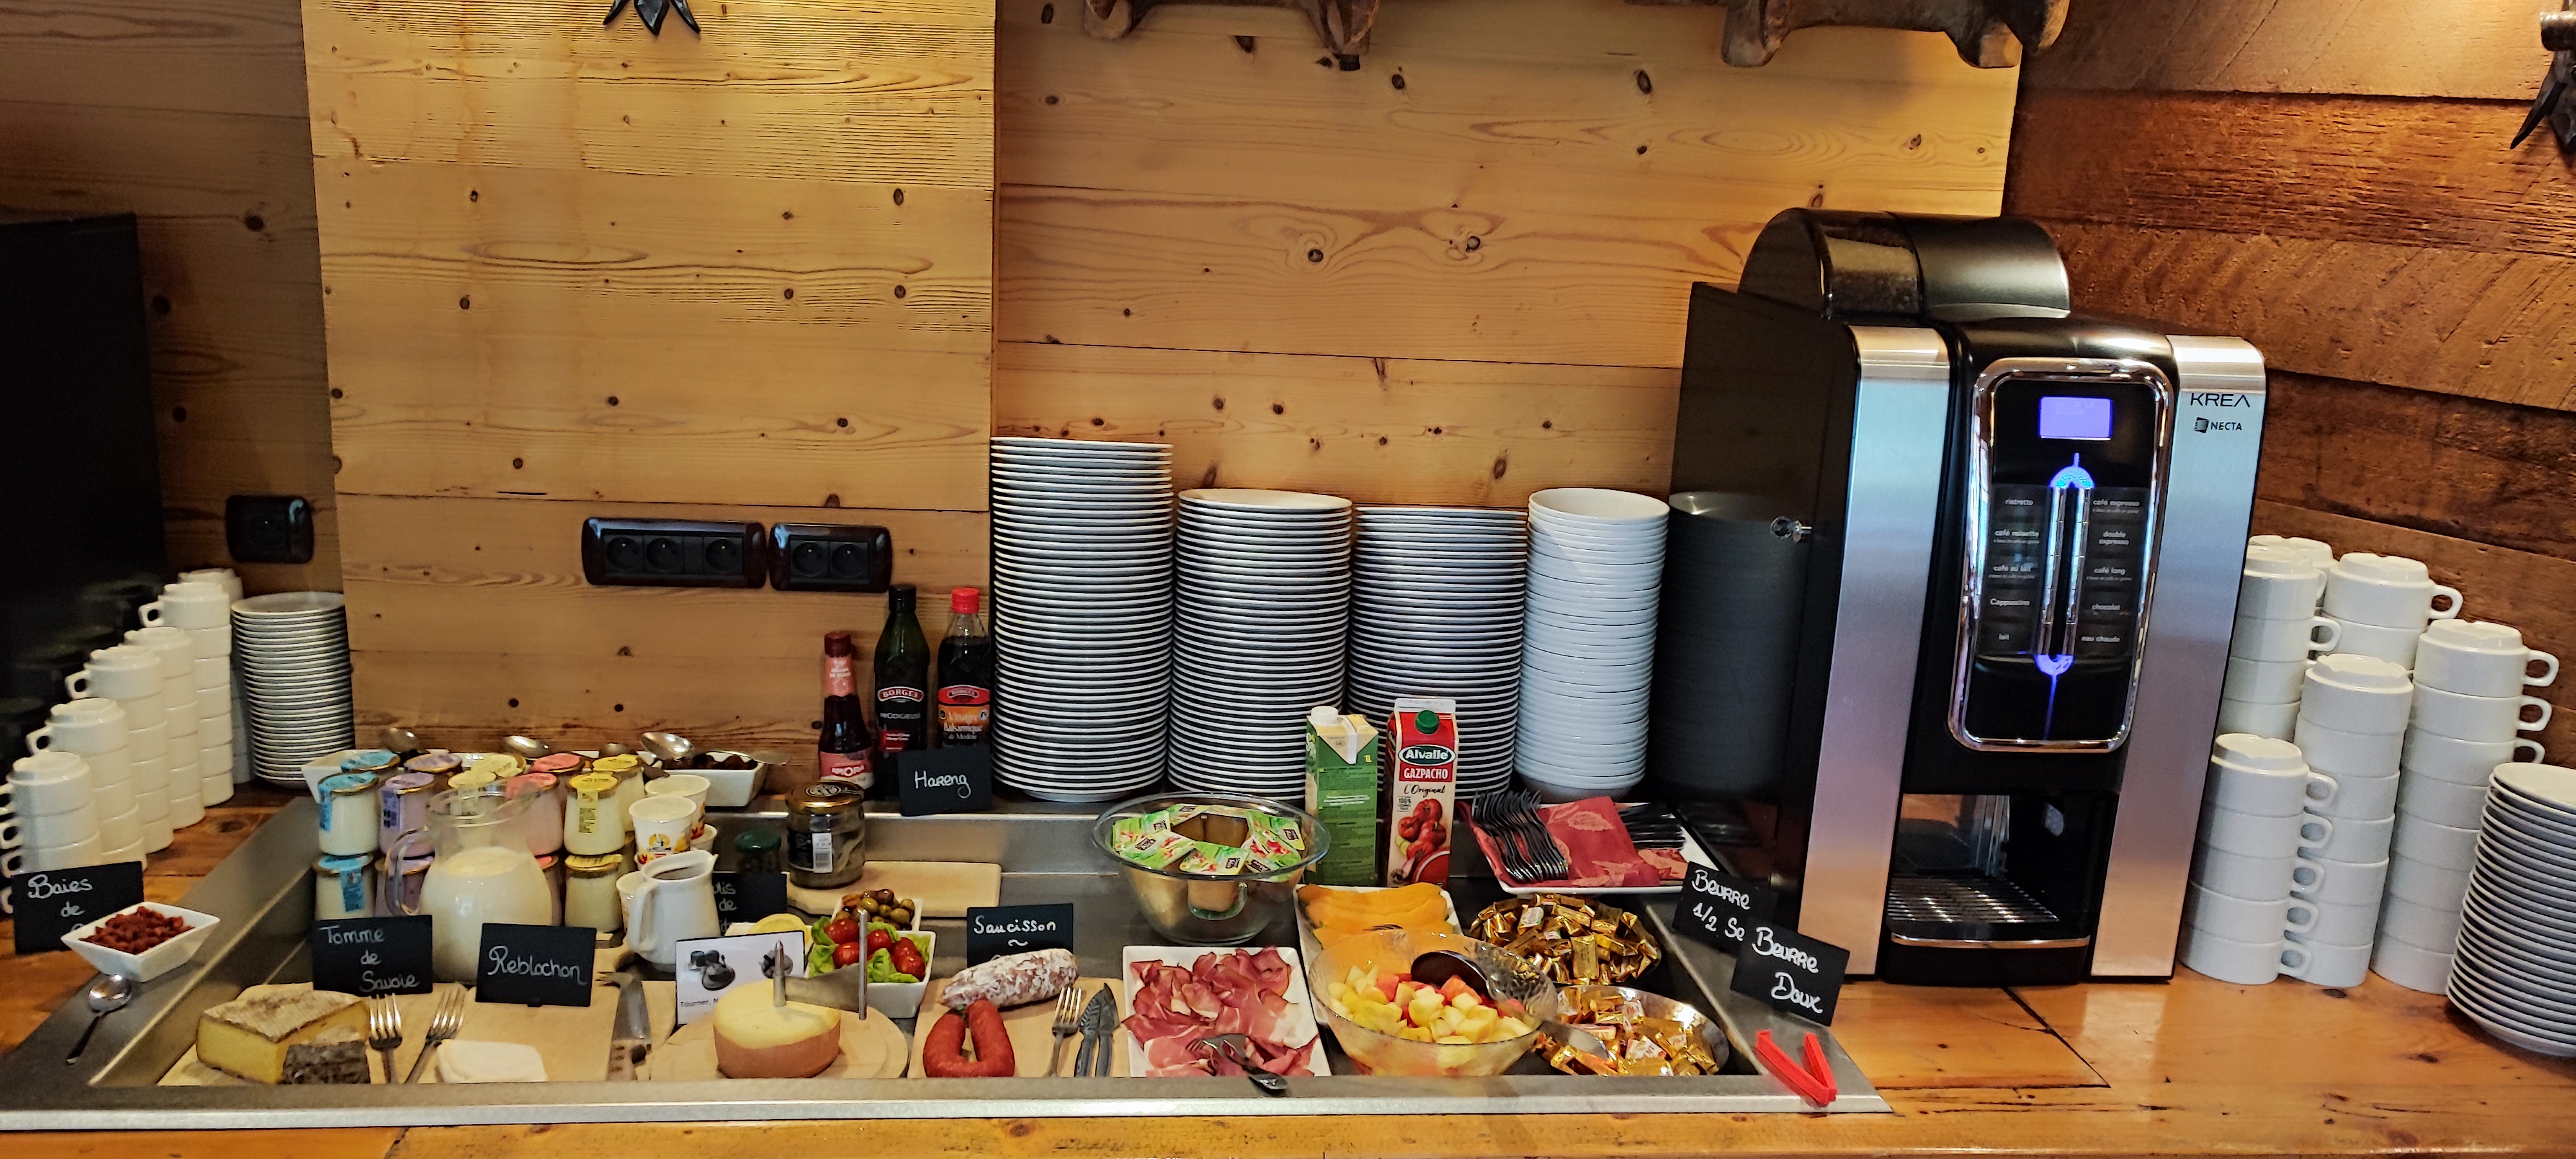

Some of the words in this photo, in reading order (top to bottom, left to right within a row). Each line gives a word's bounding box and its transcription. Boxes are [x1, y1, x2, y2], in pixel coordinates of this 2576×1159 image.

[2190, 392, 2250, 408] KREA
[2210, 422, 2242, 431] NECTA
[2111, 567, 2126, 575] long
[1990, 598, 2030, 607] Cappuccino
[882, 689, 919, 698] BORGES
[1405, 749, 1448, 760] Alvalle
[1403, 768, 1448, 780] GAZPACHO
[28, 874, 93, 899] Baies
[61, 901, 86, 917] de
[718, 898, 737, 912] de
[973, 914, 1057, 934] Saucisson
[1692, 902, 1717, 932] 1/2
[318, 925, 385, 945] Tomme
[361, 949, 382, 965] de
[488, 945, 588, 986] Reblochon
[359, 970, 421, 993] Savoie
[1771, 972, 1824, 1014] Doux
